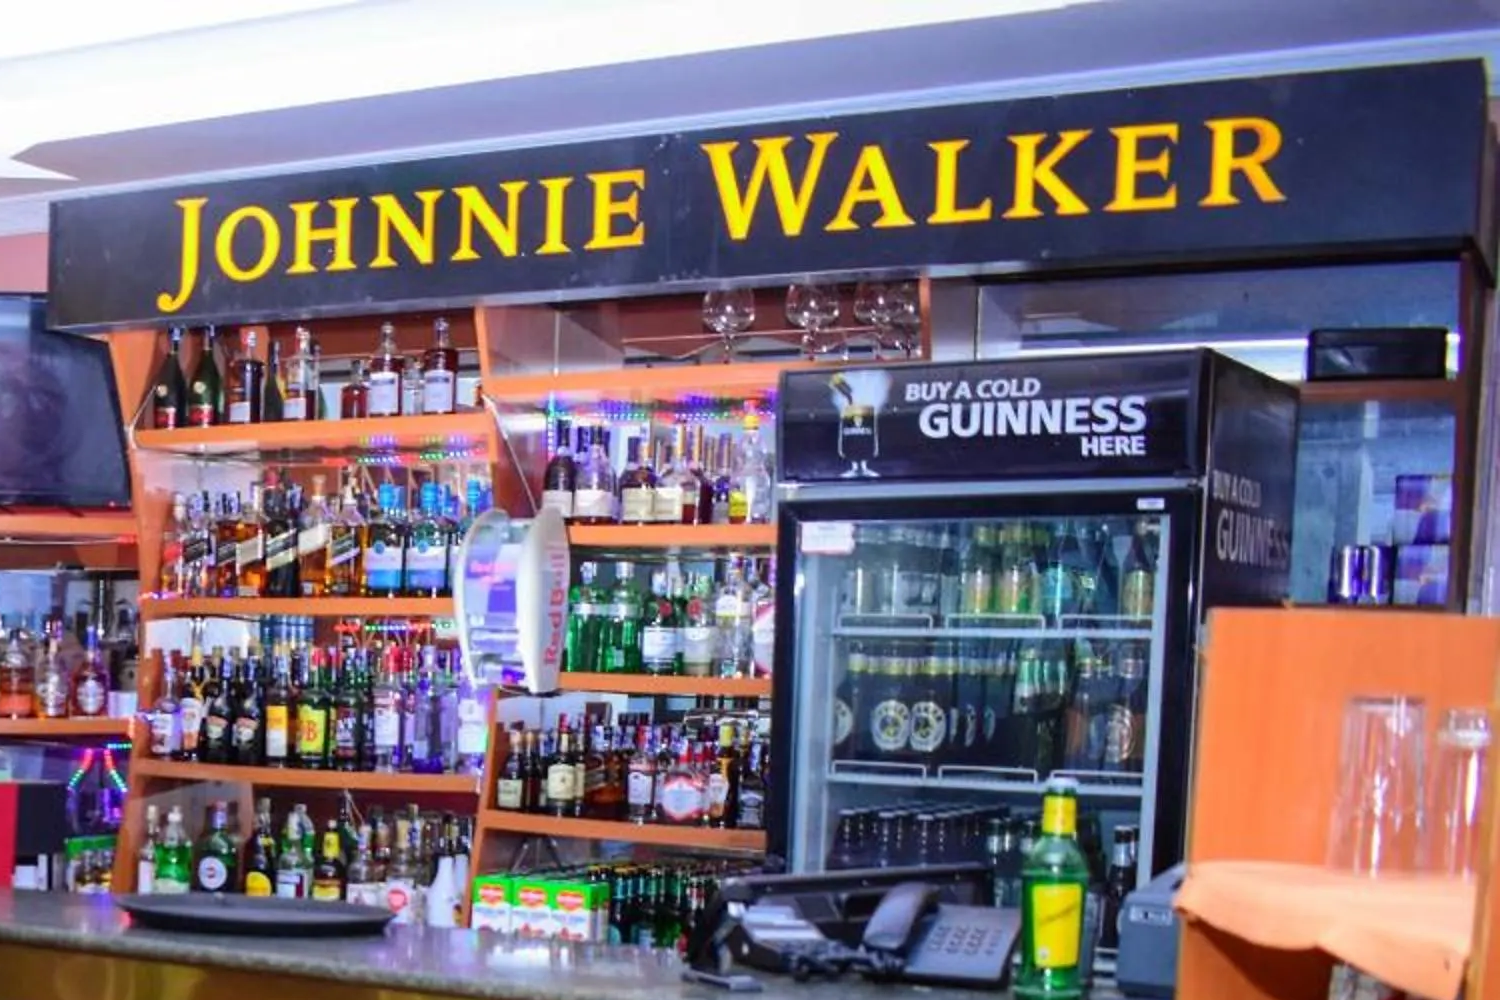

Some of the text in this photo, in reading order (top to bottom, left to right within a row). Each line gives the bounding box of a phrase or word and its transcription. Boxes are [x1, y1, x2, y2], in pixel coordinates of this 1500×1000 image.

[156, 116, 1287, 312] JOHNNIE WALKER
[905, 378, 1040, 401] BUY A COLD
[919, 396, 1147, 438] GUINNESS
[1081, 435, 1146, 456] HERE
